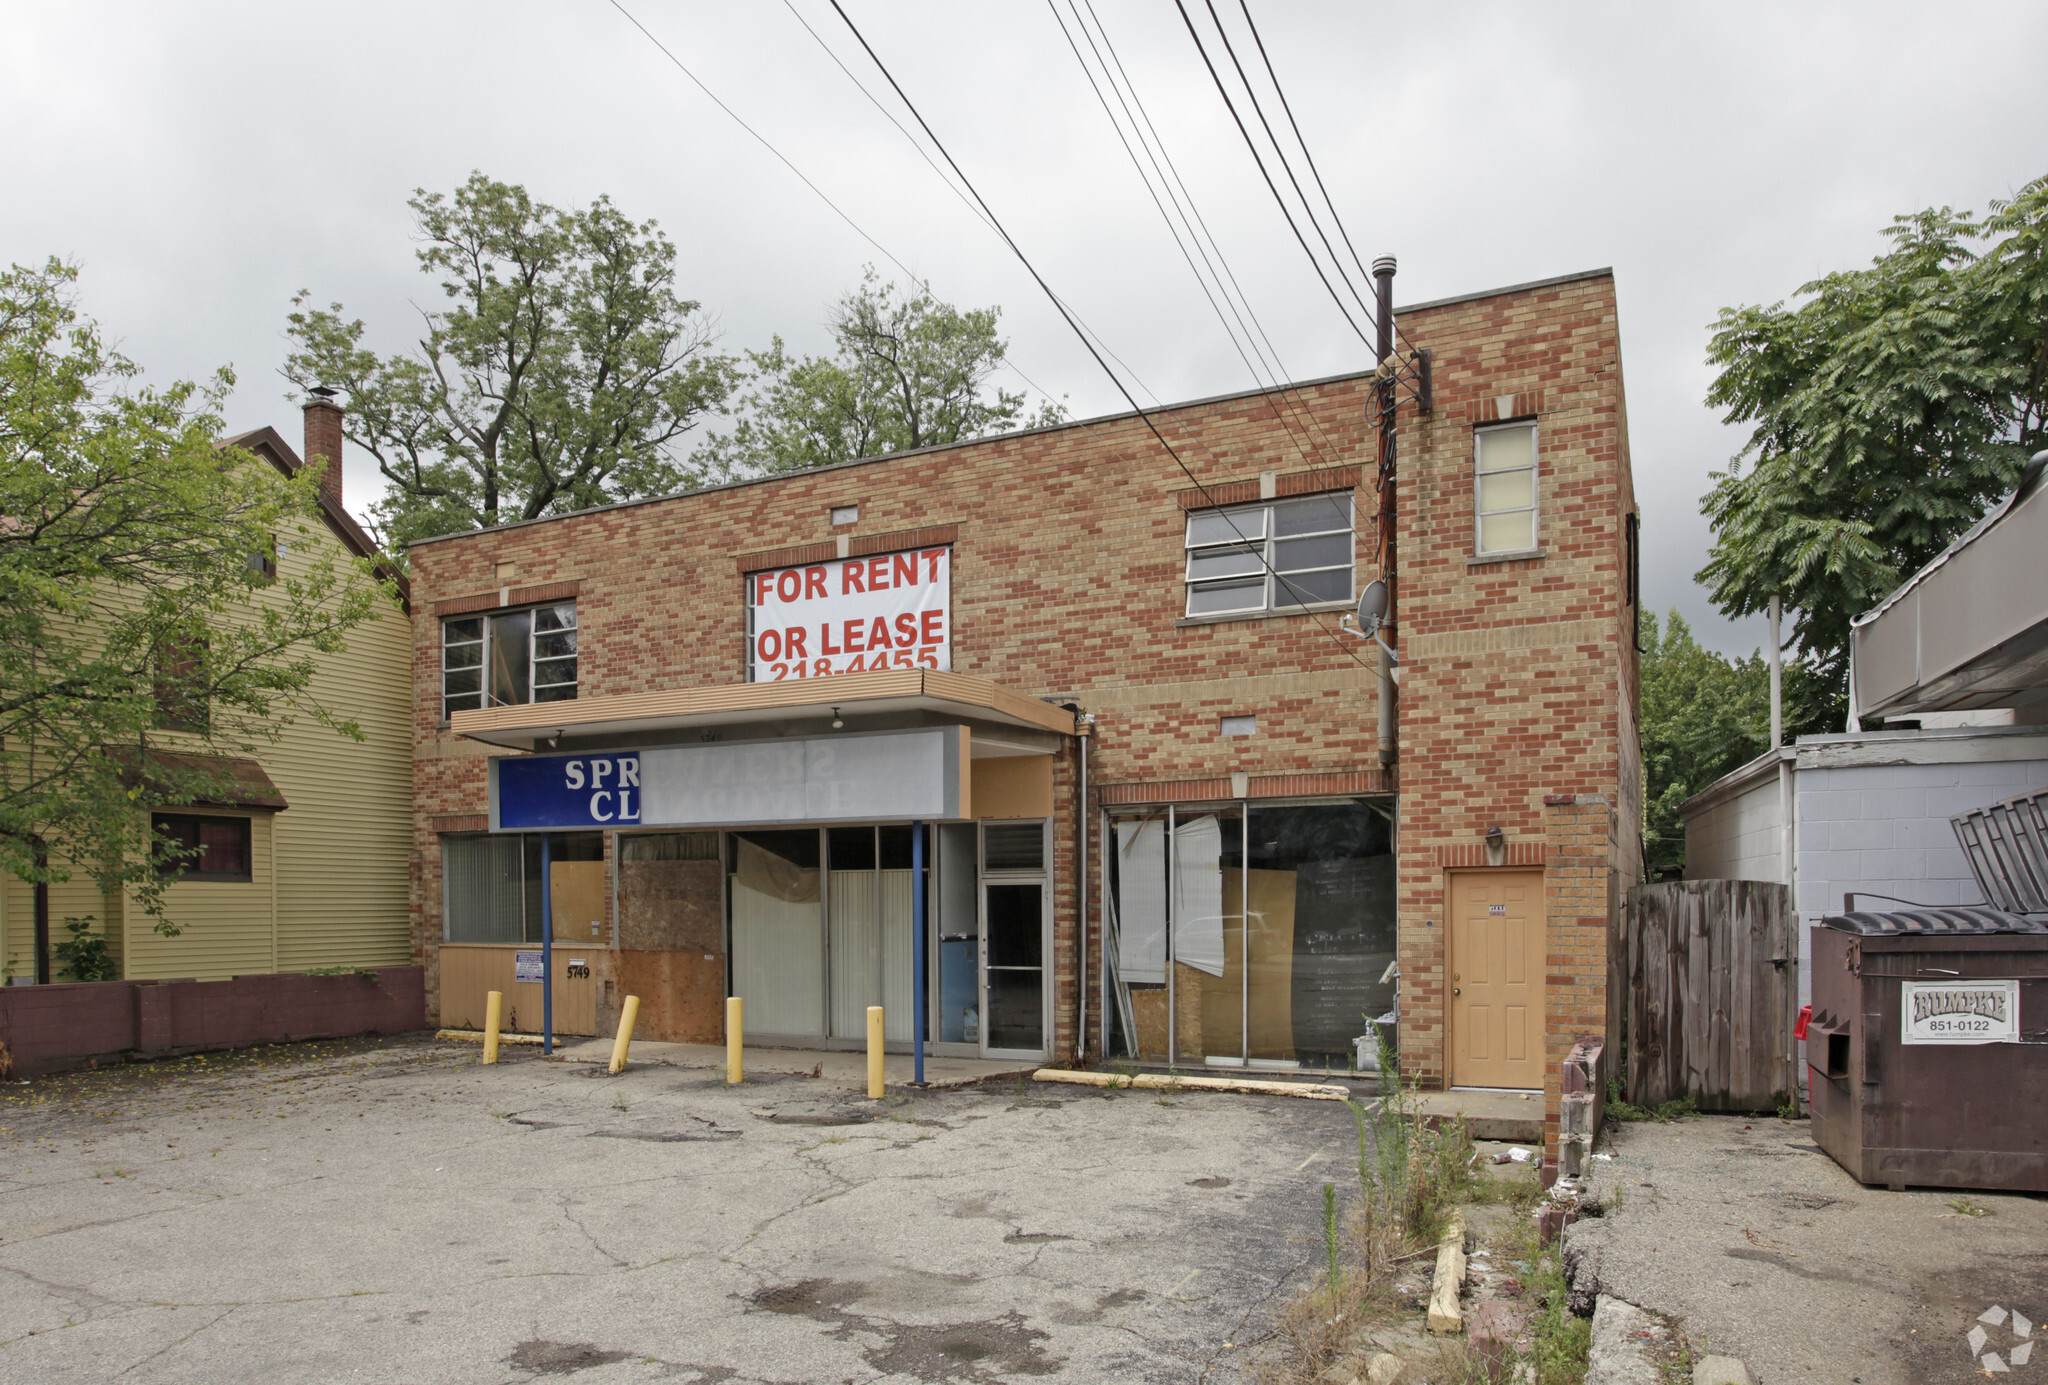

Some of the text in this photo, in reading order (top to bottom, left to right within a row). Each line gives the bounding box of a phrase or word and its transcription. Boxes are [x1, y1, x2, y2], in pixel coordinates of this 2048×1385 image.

[757, 548, 946, 606] FOR RENT
[758, 609, 944, 662] OR LEASE
[565, 757, 640, 790] SPR
[566, 966, 590, 979] 5749
[1914, 991, 2006, 1024] RUMPKE
[1930, 1021, 1990, 1031] 851-0122
